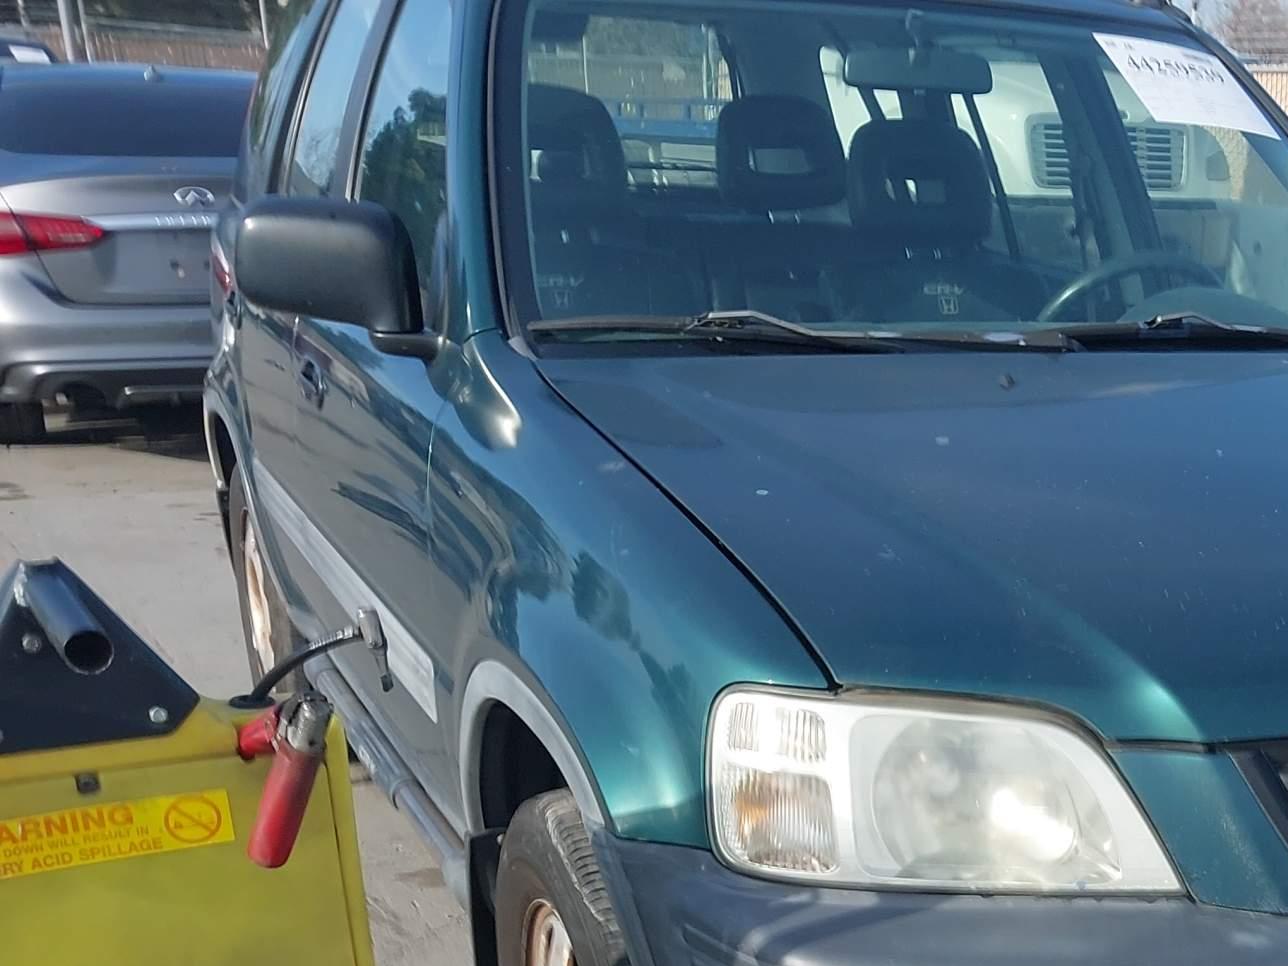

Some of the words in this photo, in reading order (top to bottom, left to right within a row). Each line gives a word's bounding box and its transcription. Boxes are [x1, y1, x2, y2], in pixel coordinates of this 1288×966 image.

[1127, 54, 1224, 82] 44259539
[47, 836, 78, 849] WILL
[136, 826, 149, 835] IN
[0, 860, 24, 876] RY
[31, 852, 73, 870] ACID
[78, 836, 163, 862] SPILLAGE
